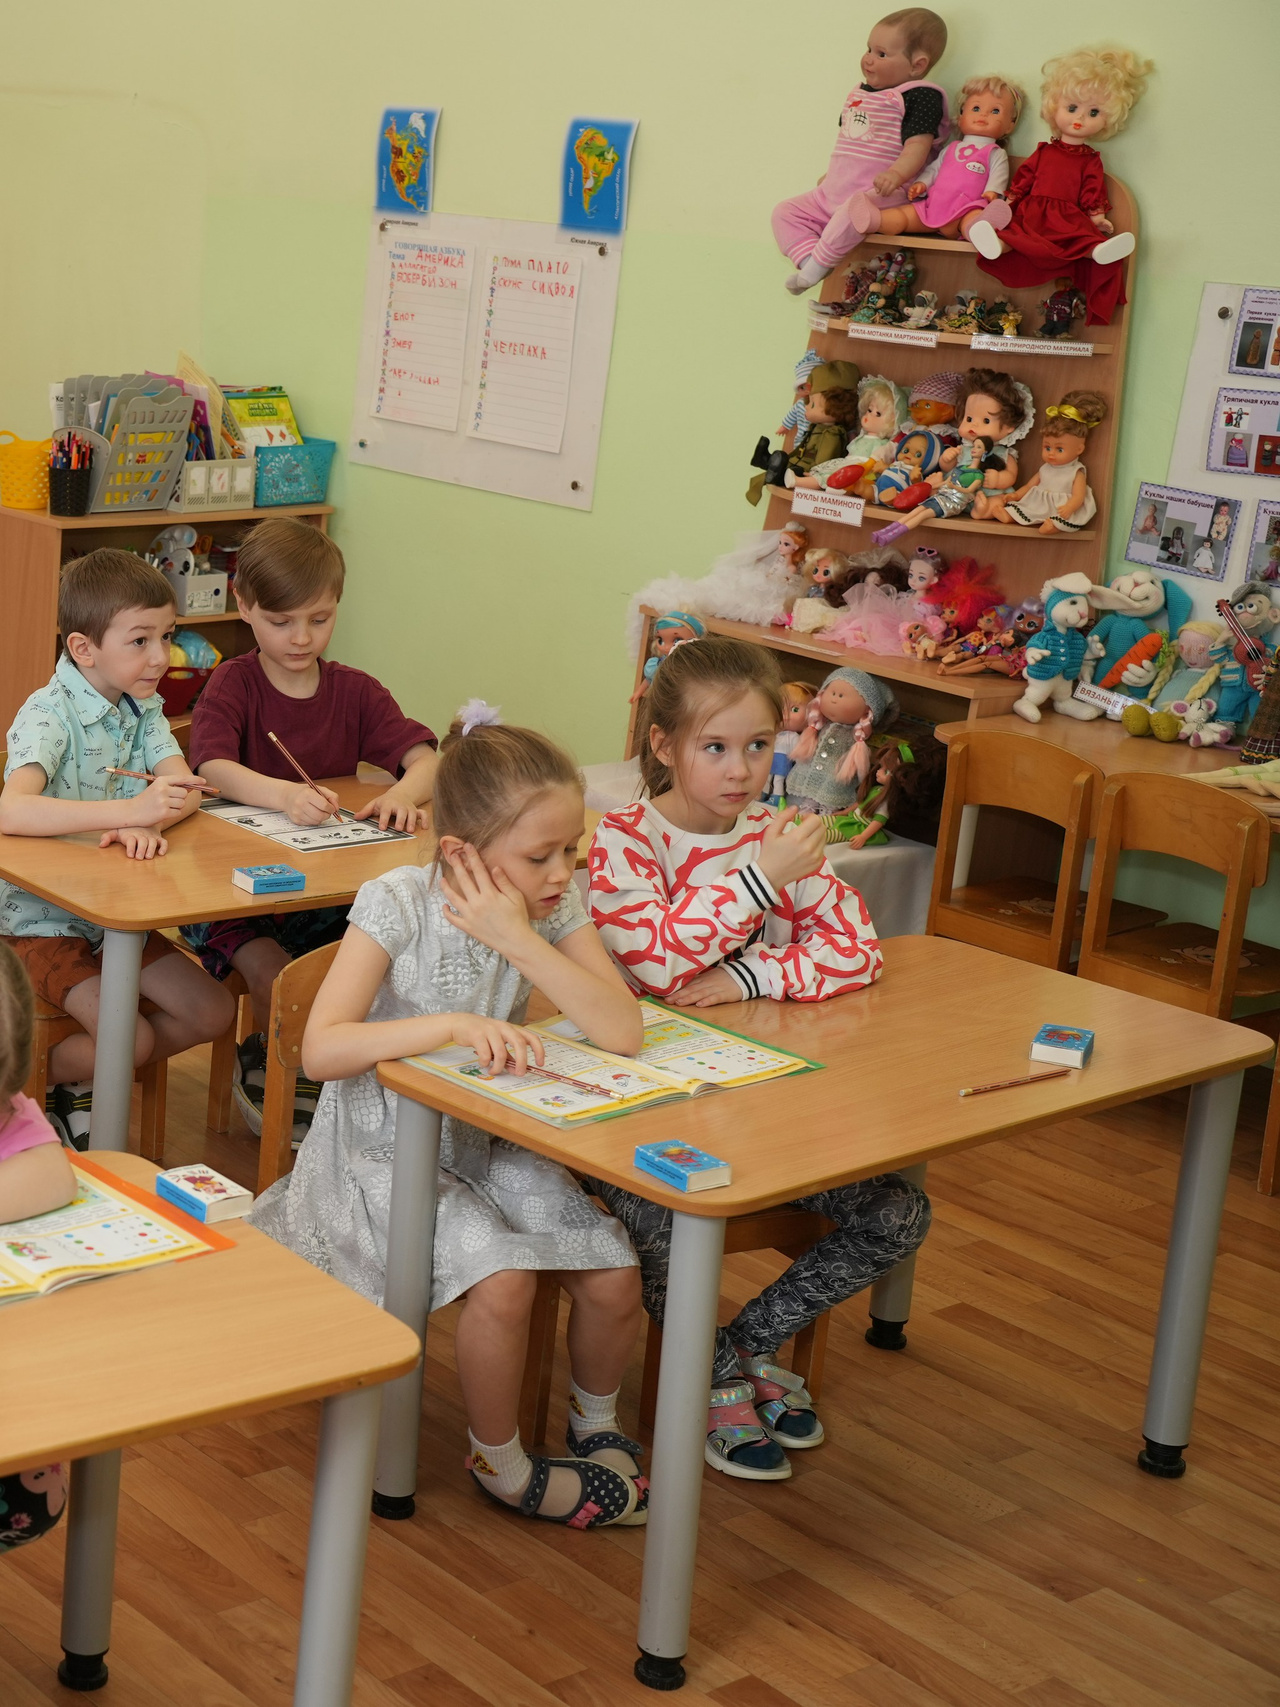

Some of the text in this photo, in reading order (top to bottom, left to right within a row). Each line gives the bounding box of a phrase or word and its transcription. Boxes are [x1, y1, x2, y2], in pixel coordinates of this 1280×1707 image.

[388, 251, 406, 260] Тема
[394, 241, 466, 256] ГОВОРЯЩАЯ АЗБУКА
[416, 249, 464, 268] АМЕРИКА
[527, 259, 569, 275] ПЛАТО
[532, 280, 575, 299] СИКВОЯ
[394, 312, 415, 321] ЕНОТ
[851, 328, 933, 342] КУКЛА-МОТАНКА МАРТИНИЧКА
[391, 338, 412, 350] ЗМЕЯ
[493, 340, 547, 360] ЧЕРЕПАХА
[977, 340, 998, 348] КУКЛЫ
[1009, 342, 1052, 351] ПРИРОДНОГО
[1052, 345, 1090, 353] МАТЕРИАЛА
[1223, 395, 1259, 404] Тряпичная
[795, 492, 862, 511] КУКЛЫ МАМИНОГО
[1144, 490, 1214, 510] Куклы наших бабушек
[812, 506, 842, 518] ДЕТСТВА
[1079, 686, 1120, 709] ВЯЗАНЫЕ
